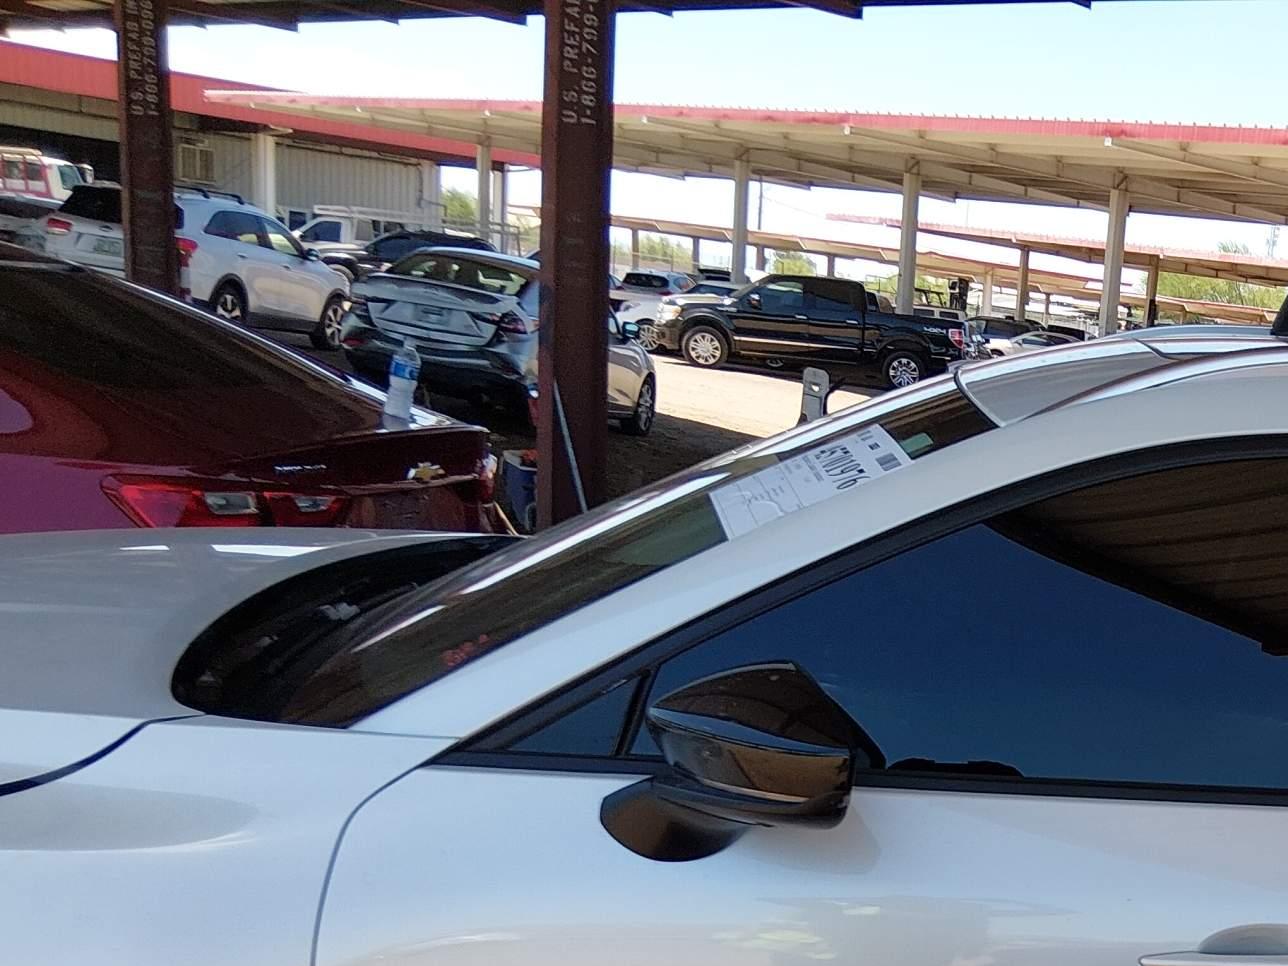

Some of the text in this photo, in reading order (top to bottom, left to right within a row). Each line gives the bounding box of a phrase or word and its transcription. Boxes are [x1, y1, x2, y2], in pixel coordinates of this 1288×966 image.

[126, 21, 142, 80] PREFAB
[561, 0, 581, 124] U.S. PREFA
[581, 0, 599, 125] 1-866-799-
